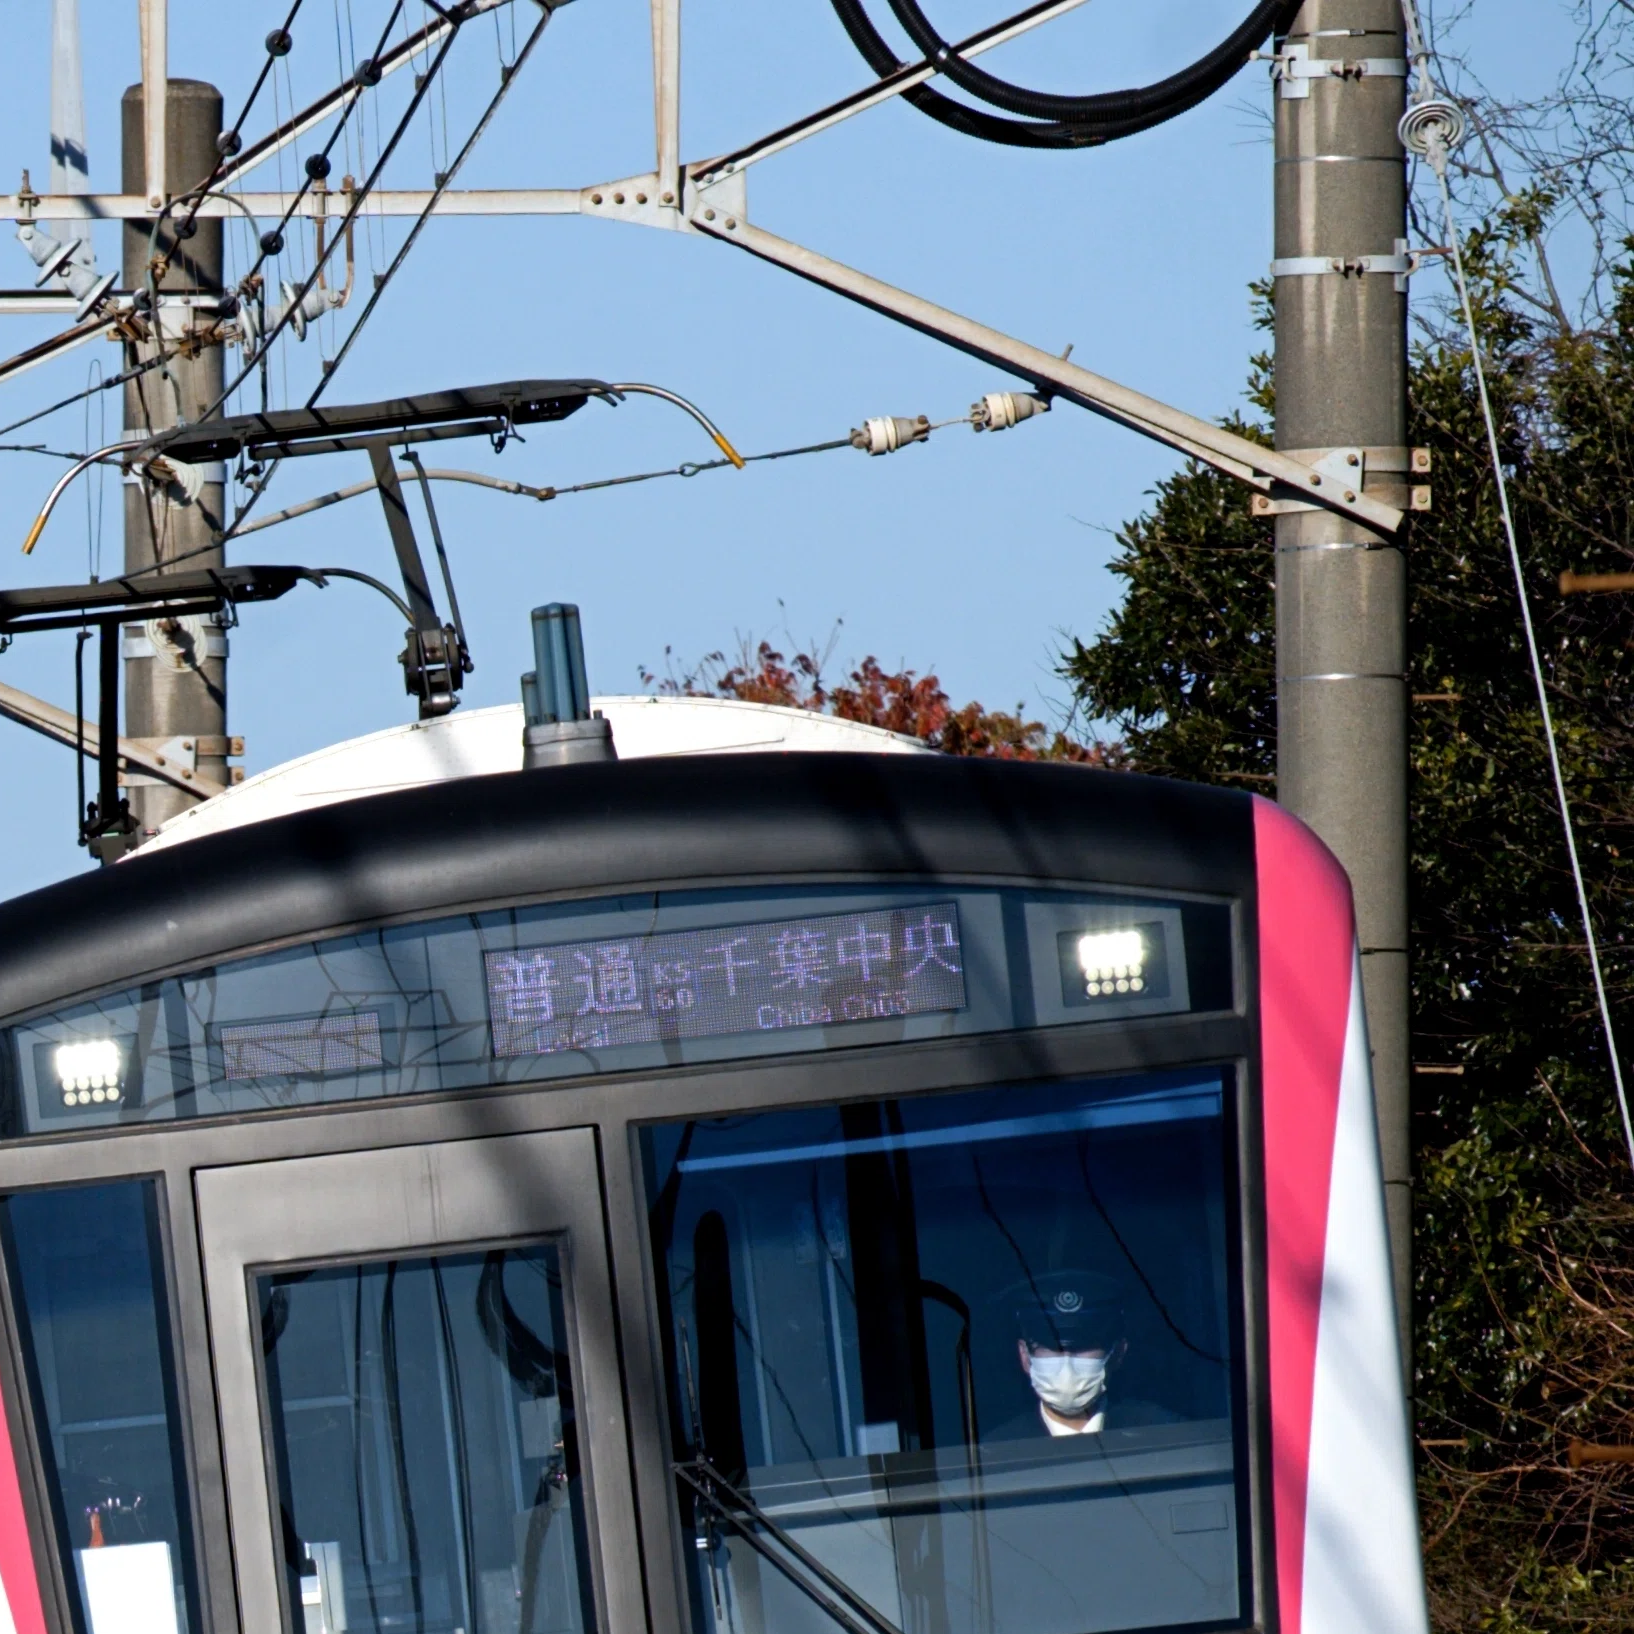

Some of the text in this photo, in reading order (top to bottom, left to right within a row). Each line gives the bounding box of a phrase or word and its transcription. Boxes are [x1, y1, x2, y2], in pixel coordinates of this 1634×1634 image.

[701, 915, 962, 996] 千葉中央
[495, 946, 642, 1023] 普通
[653, 961, 690, 985] KS
[655, 987, 694, 1010] 60
[757, 1000, 833, 1030] Chiba
